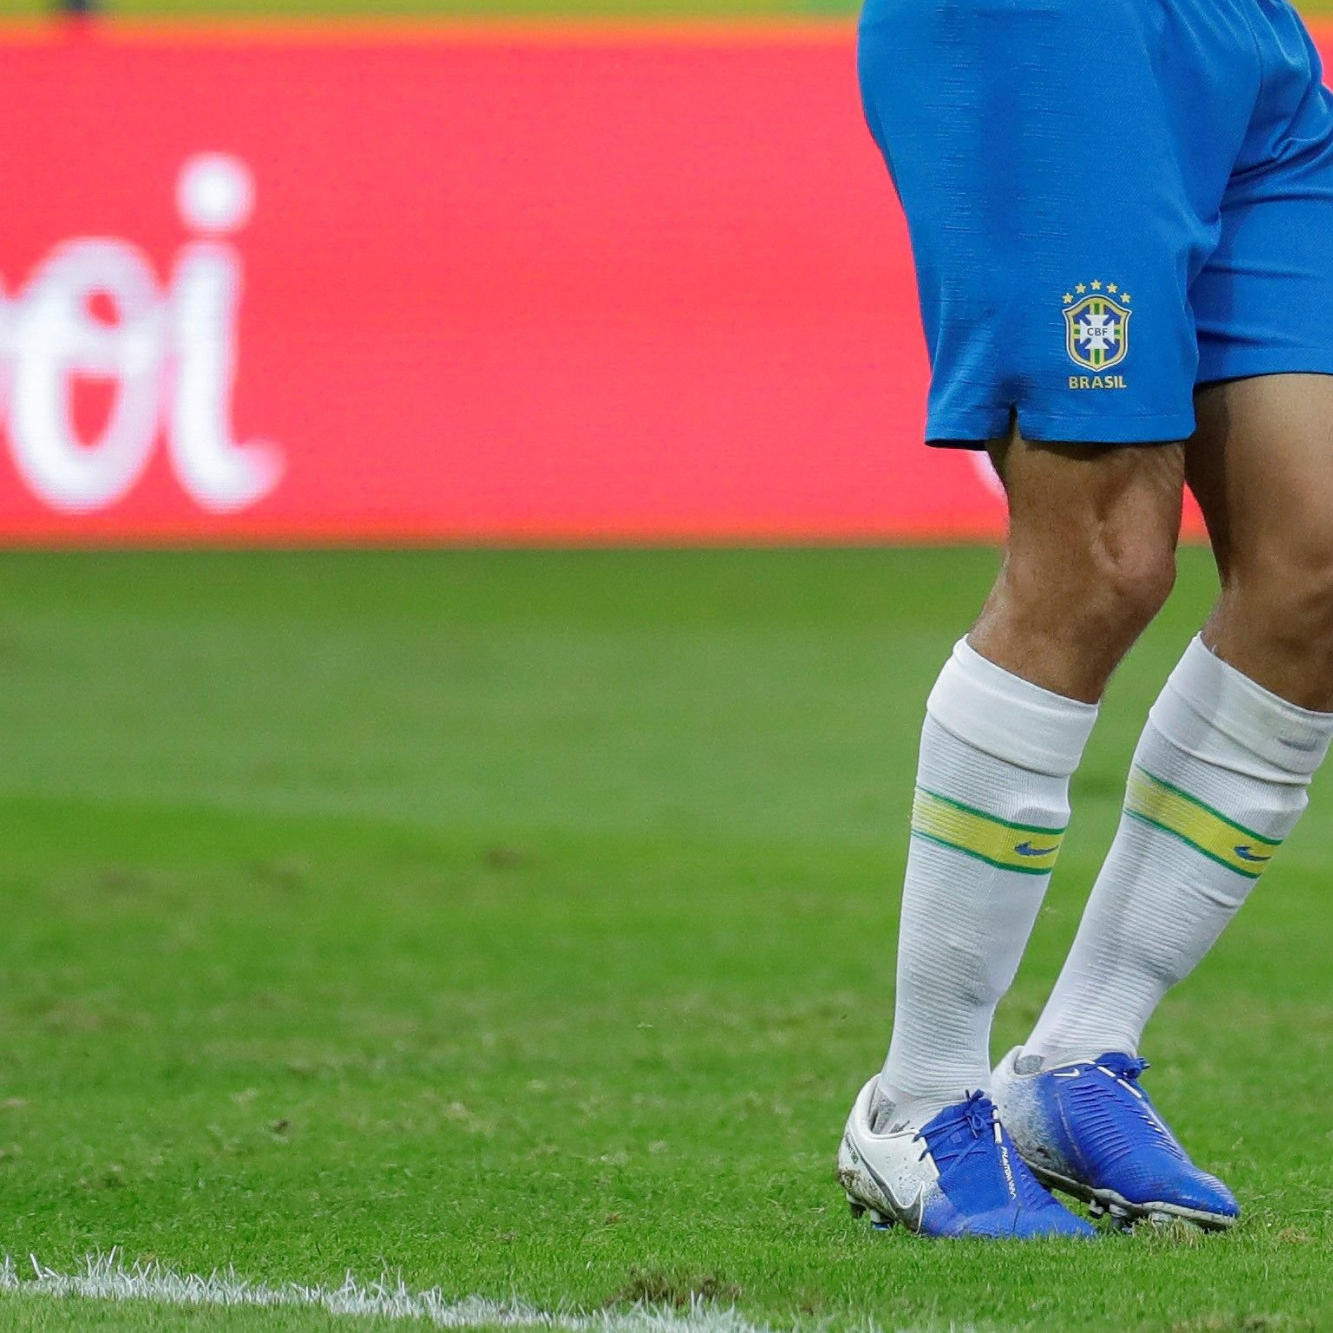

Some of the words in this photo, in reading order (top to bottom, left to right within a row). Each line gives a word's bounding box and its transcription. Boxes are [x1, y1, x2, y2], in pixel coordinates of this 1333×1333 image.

[0, 151, 286, 513] oi
[1087, 327, 1108, 336] CBF
[1068, 376, 1127, 389] BRASIL
